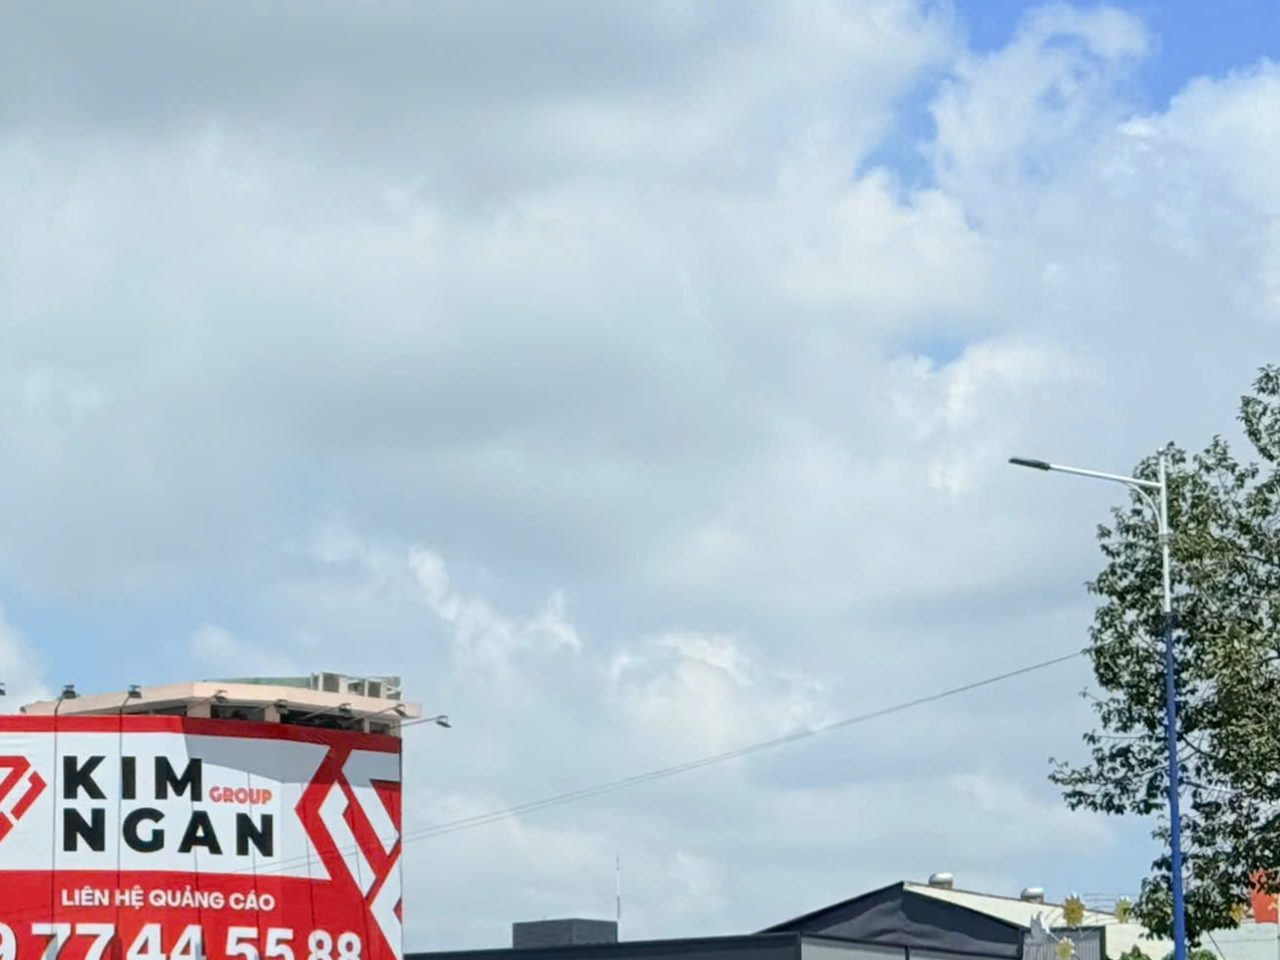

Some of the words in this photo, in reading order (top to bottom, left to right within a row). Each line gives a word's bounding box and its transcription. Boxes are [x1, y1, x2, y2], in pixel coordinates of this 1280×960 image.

[63, 756, 202, 801] KIM
[209, 786, 272, 804] GROUP
[63, 807, 273, 857] NGAN
[61, 886, 109, 906] LIÊN
[115, 885, 144, 910] HỆ
[149, 886, 225, 909] QUẢNG
[229, 890, 275, 910] CÁO
